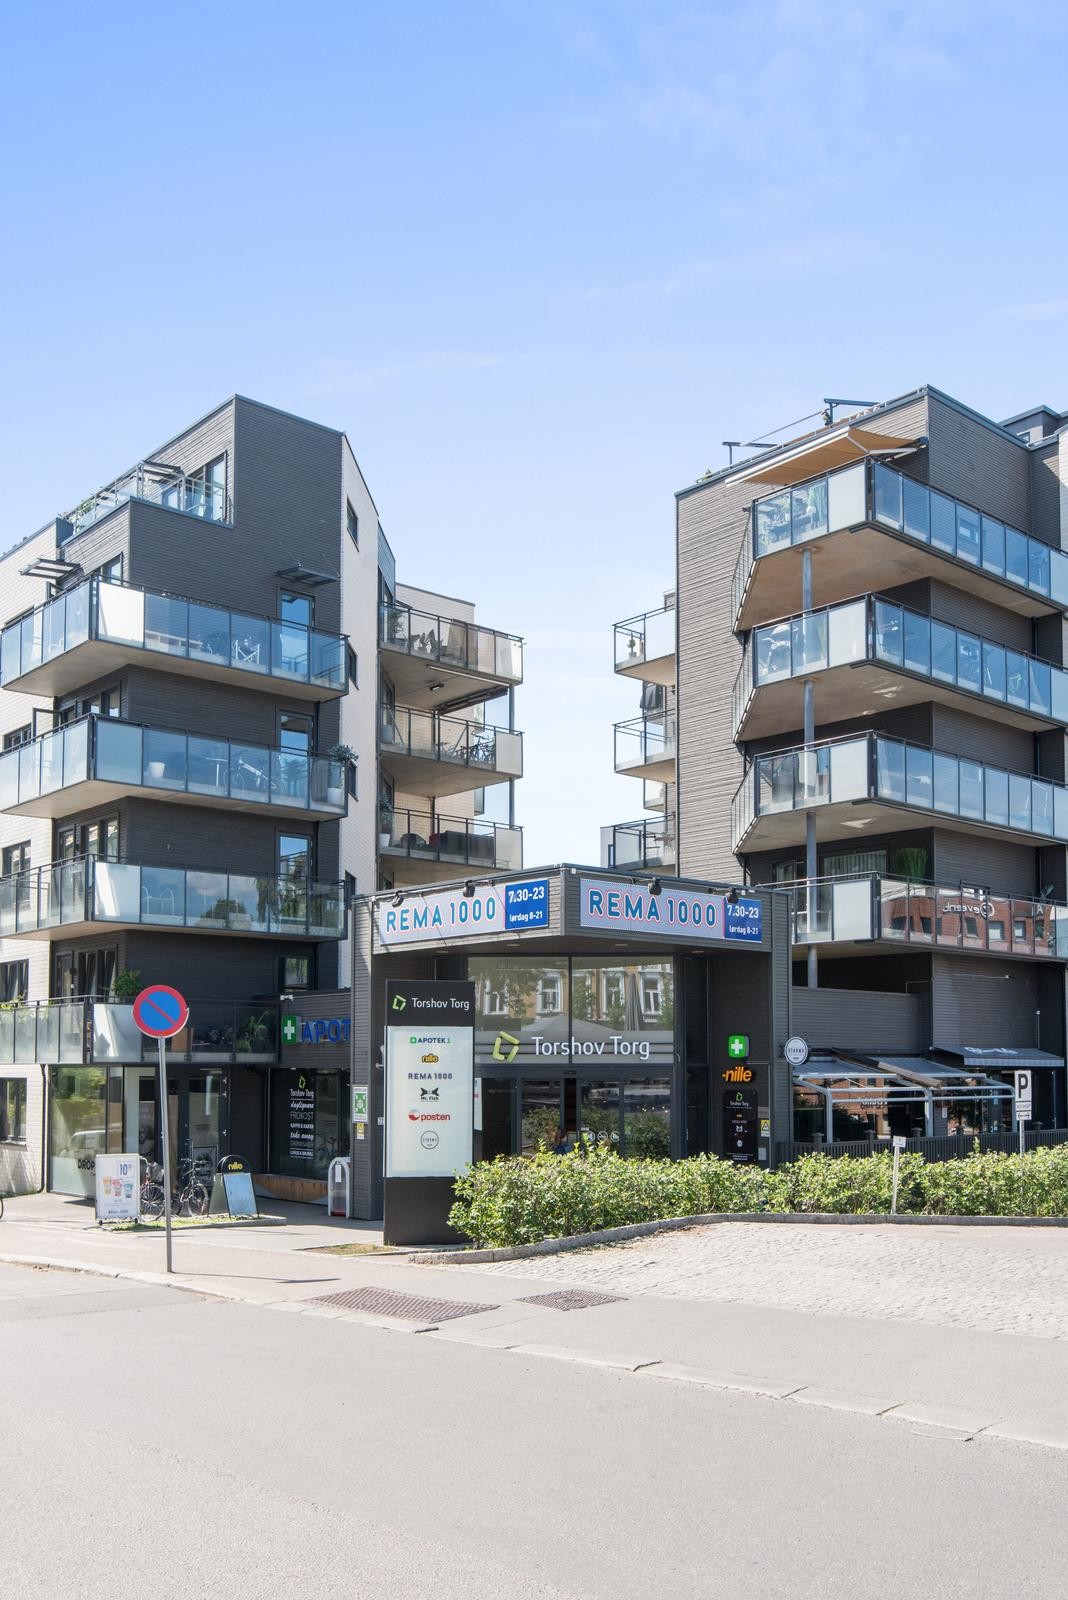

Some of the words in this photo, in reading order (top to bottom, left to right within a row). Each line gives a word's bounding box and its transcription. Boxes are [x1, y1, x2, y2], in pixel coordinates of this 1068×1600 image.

[508, 886, 545, 903] 7.30-23
[386, 904, 443, 933] REMA
[449, 896, 497, 926] 1000
[509, 912, 529, 922] lørdag
[529, 911, 543, 920] 8-21
[588, 889, 661, 923] REMA
[667, 898, 717, 928] 1000
[727, 905, 759, 919] 7.30-23
[728, 925, 746, 935] lørdag
[746, 927, 759, 935] 8-21
[411, 998, 448, 1008] Torshov
[449, 998, 470, 1011] Torg
[302, 1018, 352, 1044] APOT
[531, 1036, 605, 1056] Torshov
[609, 1036, 650, 1060] Torg
[724, 1066, 752, 1082] nille
[1018, 1073, 1029, 1099] P
[420, 1113, 451, 1122] posten
